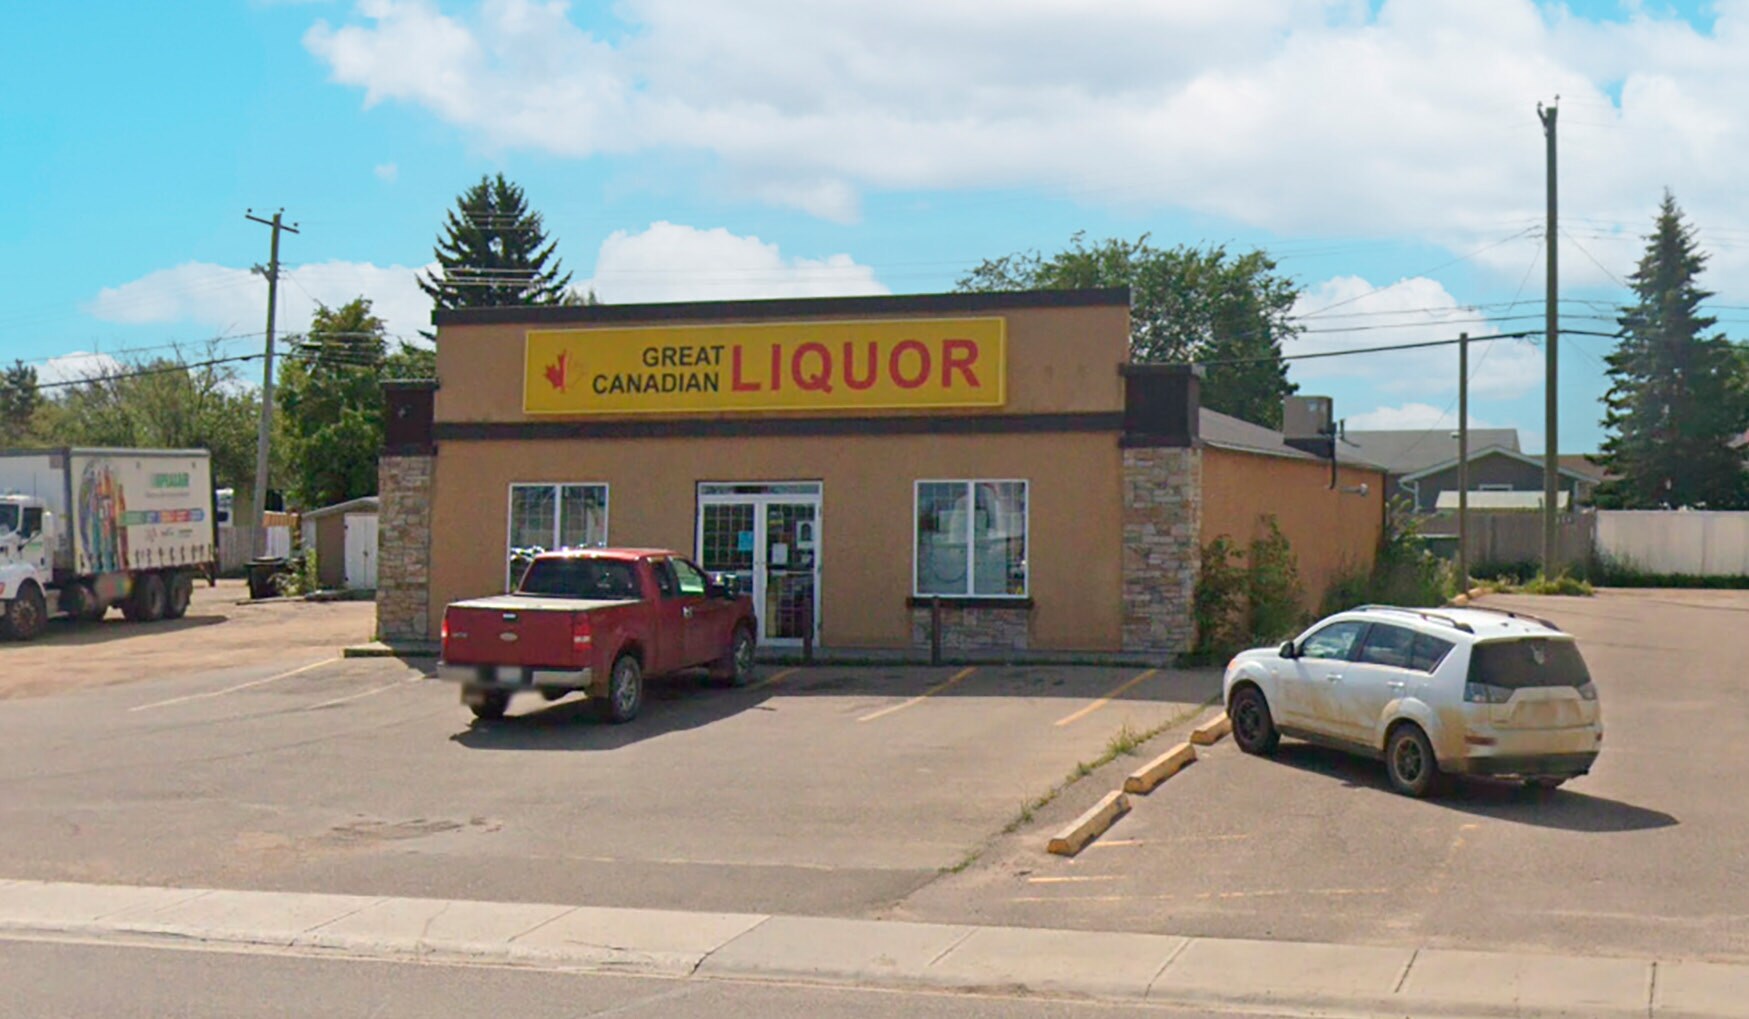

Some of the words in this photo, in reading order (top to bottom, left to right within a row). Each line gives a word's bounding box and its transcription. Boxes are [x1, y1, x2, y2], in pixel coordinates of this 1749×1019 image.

[642, 346, 725, 368] GREAT
[731, 339, 981, 395] LIQUOR
[592, 372, 719, 395] CANADIAN
